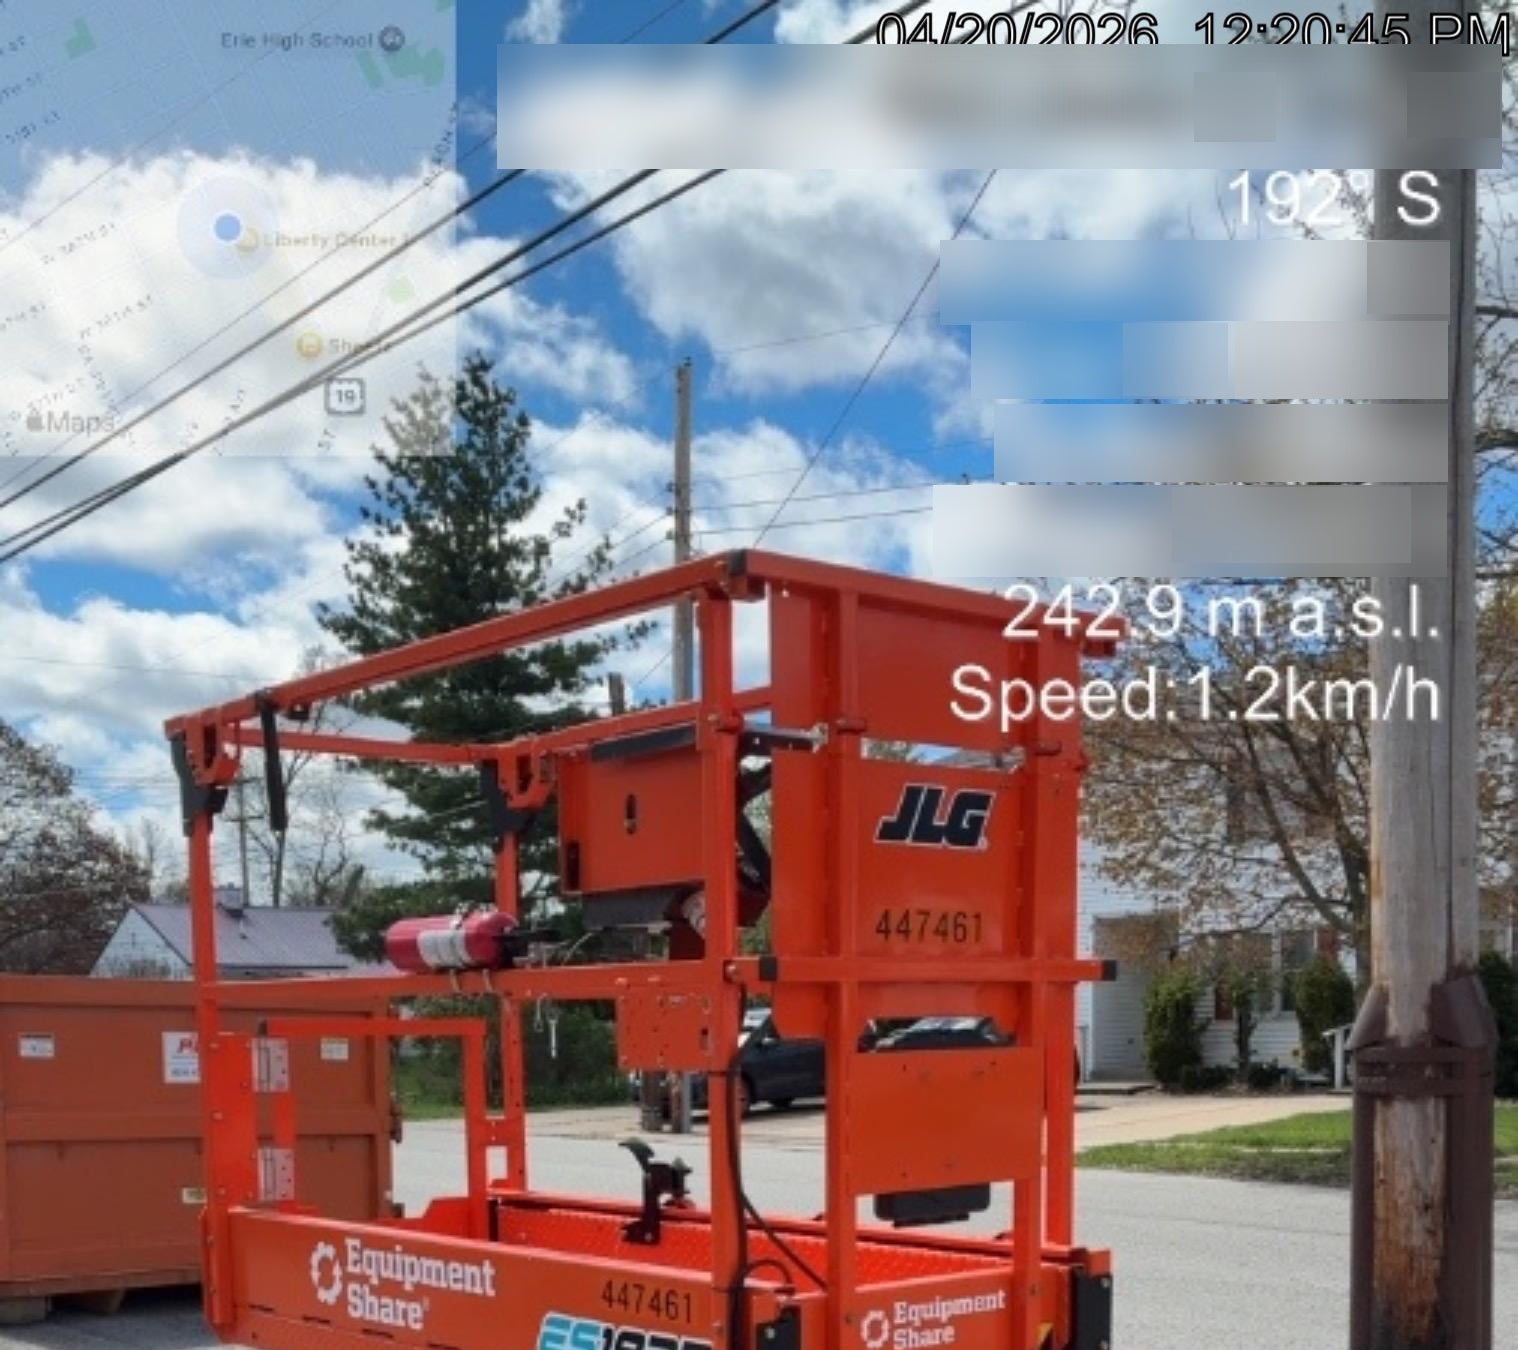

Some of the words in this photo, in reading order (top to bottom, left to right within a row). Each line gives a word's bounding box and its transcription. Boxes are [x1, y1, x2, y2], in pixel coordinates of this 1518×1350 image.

[874, 783, 995, 849] JLG
[876, 909, 983, 943] 447461
[345, 1238, 496, 1297] Equipment
[601, 1280, 693, 1323] 447461
[894, 1289, 1006, 1325] Equipment
[893, 1325, 955, 1350] Share
